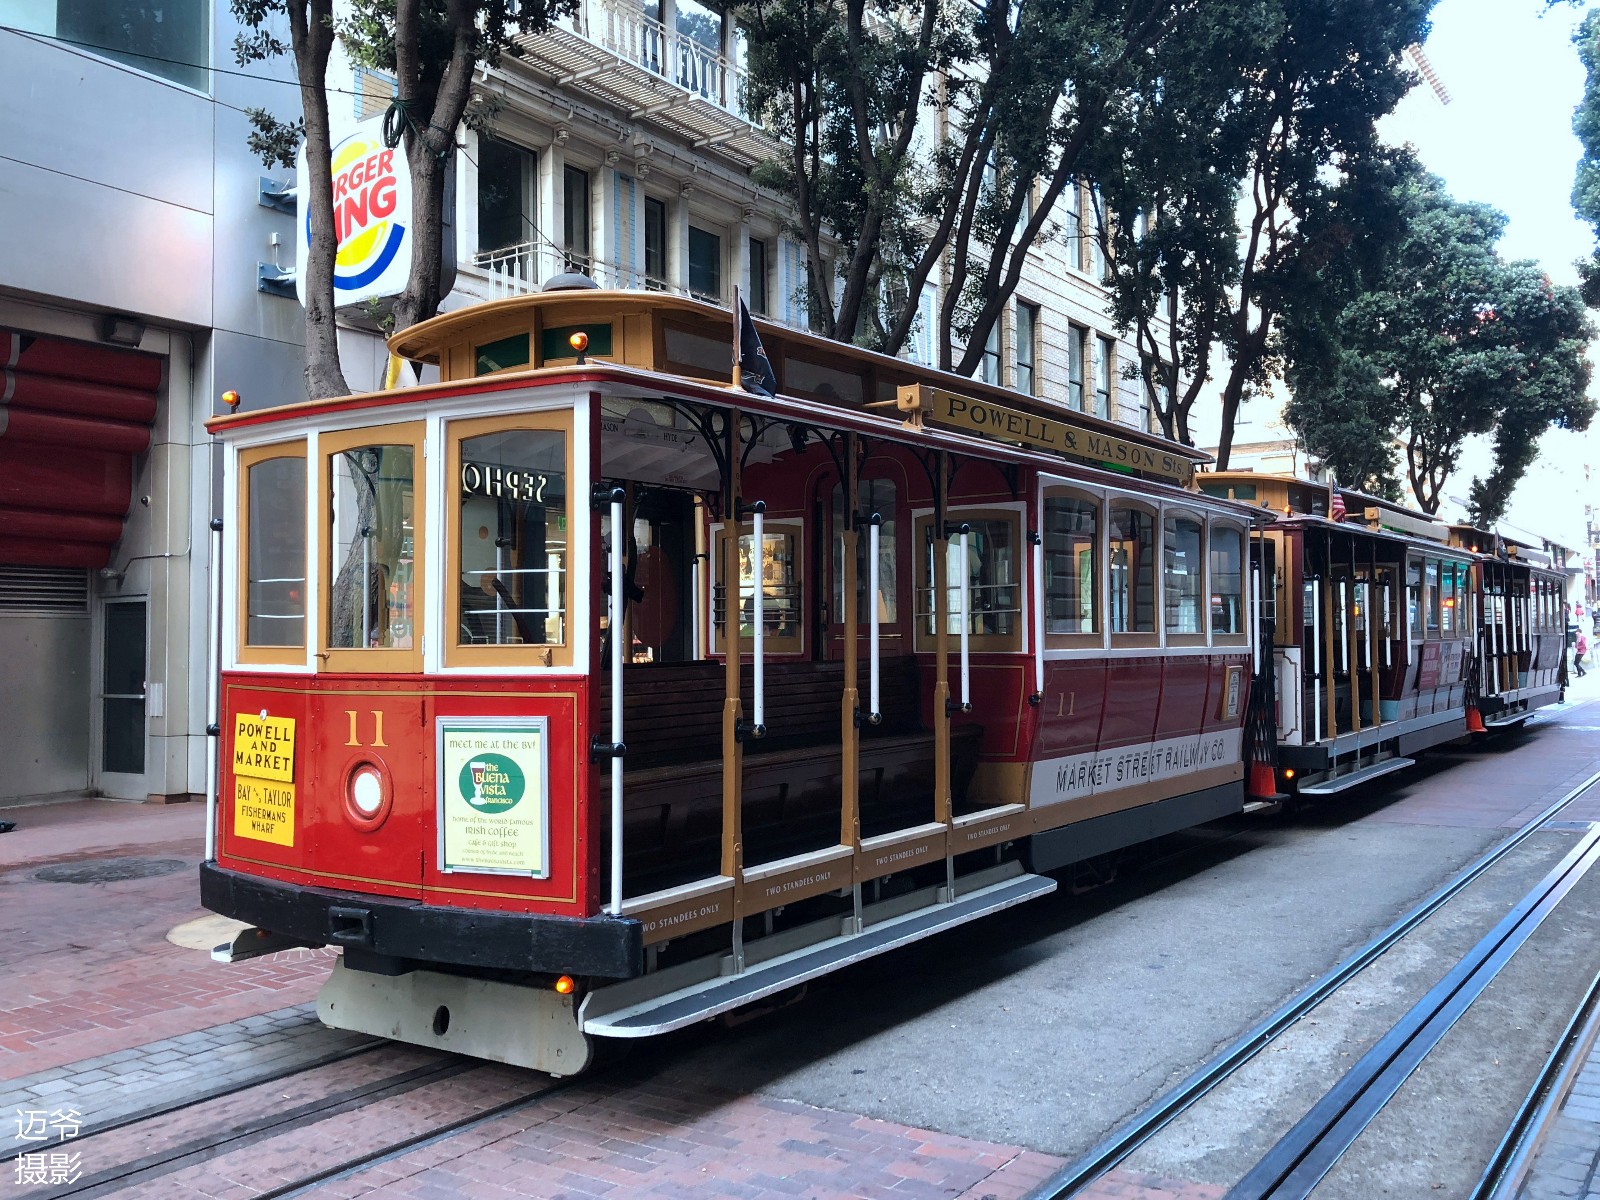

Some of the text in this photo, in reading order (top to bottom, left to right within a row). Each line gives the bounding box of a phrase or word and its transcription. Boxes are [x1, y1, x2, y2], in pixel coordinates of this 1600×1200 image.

[332, 149, 394, 203] RGER
[334, 175, 396, 246] ING
[663, 432, 678, 442] HYDE
[947, 398, 1055, 443] POWELL
[1064, 431, 1077, 450] &
[1088, 436, 1155, 468] MASON
[1056, 692, 1076, 717] 11
[239, 723, 290, 742] POWELL
[344, 710, 389, 747] 11
[251, 741, 276, 752] AND
[450, 740, 472, 749] meet
[474, 740, 489, 748] me
[502, 740, 518, 749] the
[236, 751, 290, 771] MARKET
[486, 763, 499, 771] the
[1056, 758, 1112, 793] MARKET
[1116, 750, 1164, 782] STREET
[238, 784, 251, 801] BAY
[264, 788, 292, 808] TAYLOR
[242, 806, 286, 823] FISHERMANS
[252, 820, 275, 834] WHARF
[876, 845, 929, 866] TWO STANDEES ONLY
[766, 872, 831, 897] TWO STANDEES ONLY
[642, 903, 720, 933] WO STANDEES ONLY
